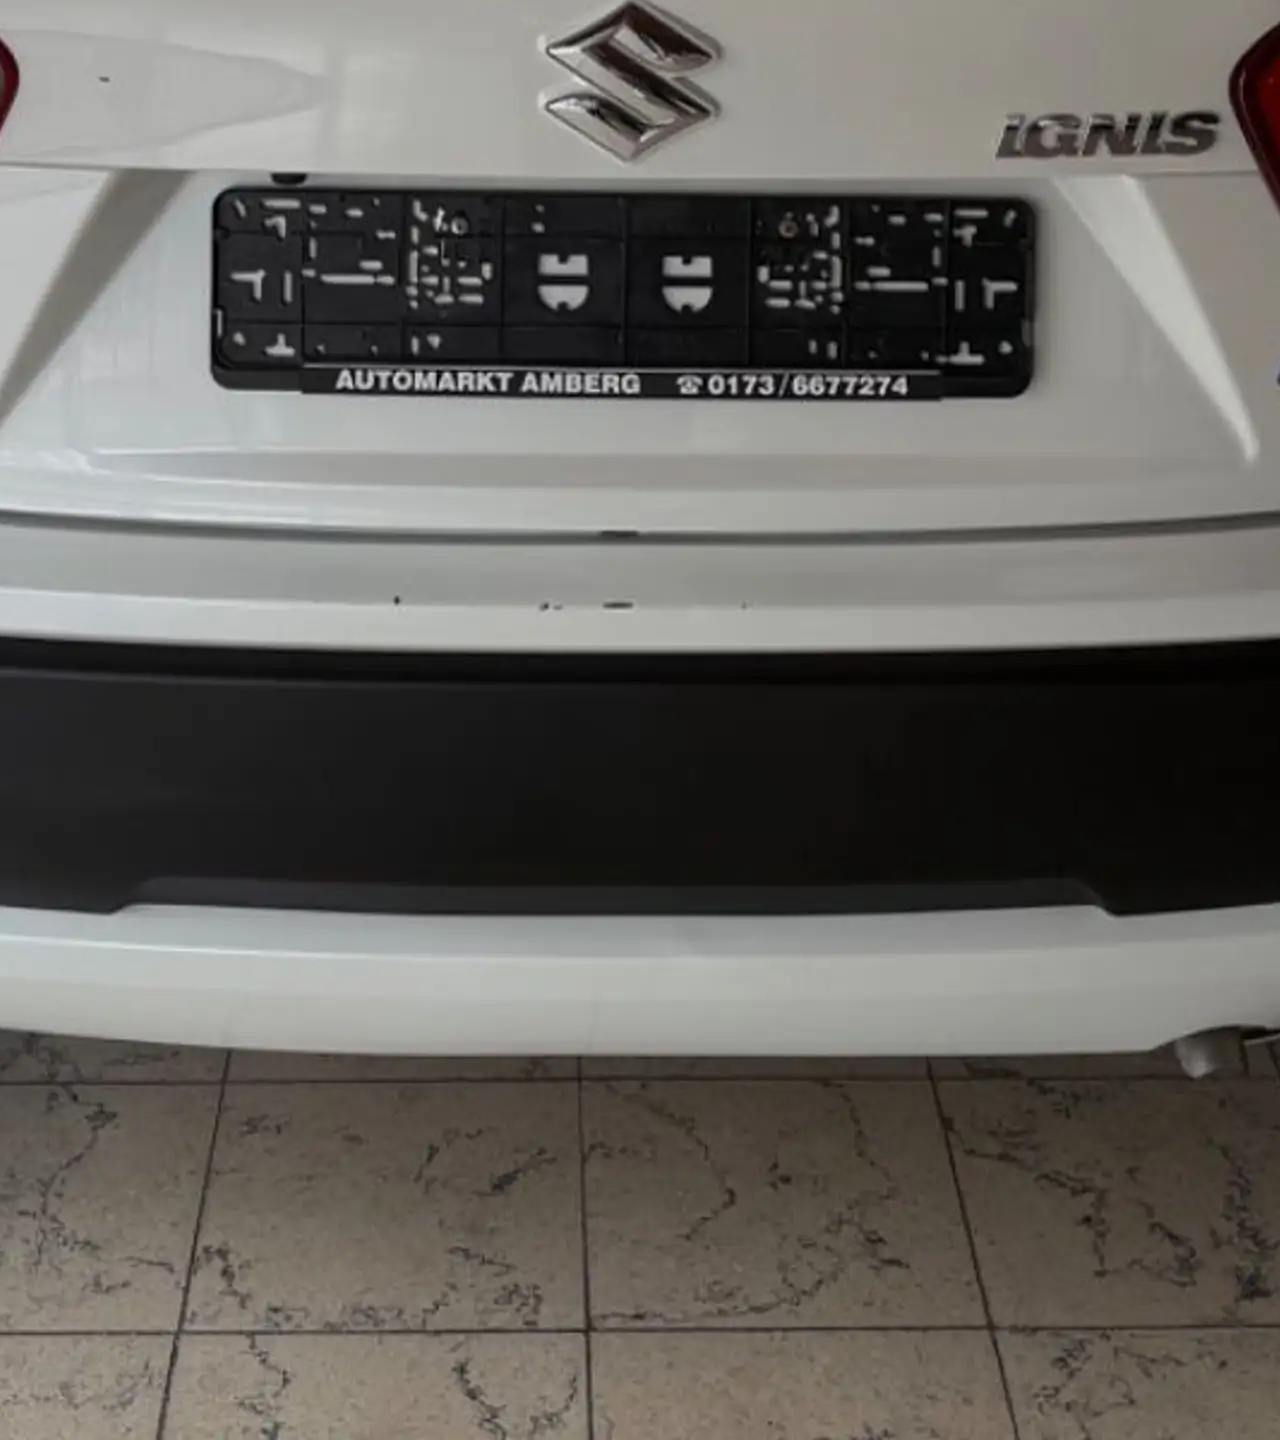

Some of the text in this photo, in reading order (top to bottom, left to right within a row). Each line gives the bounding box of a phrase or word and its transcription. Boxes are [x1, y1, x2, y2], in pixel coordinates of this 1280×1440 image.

[996, 111, 1222, 161] IGNIS
[335, 368, 514, 393] AUTOMARKT
[520, 371, 641, 395] AMBERG
